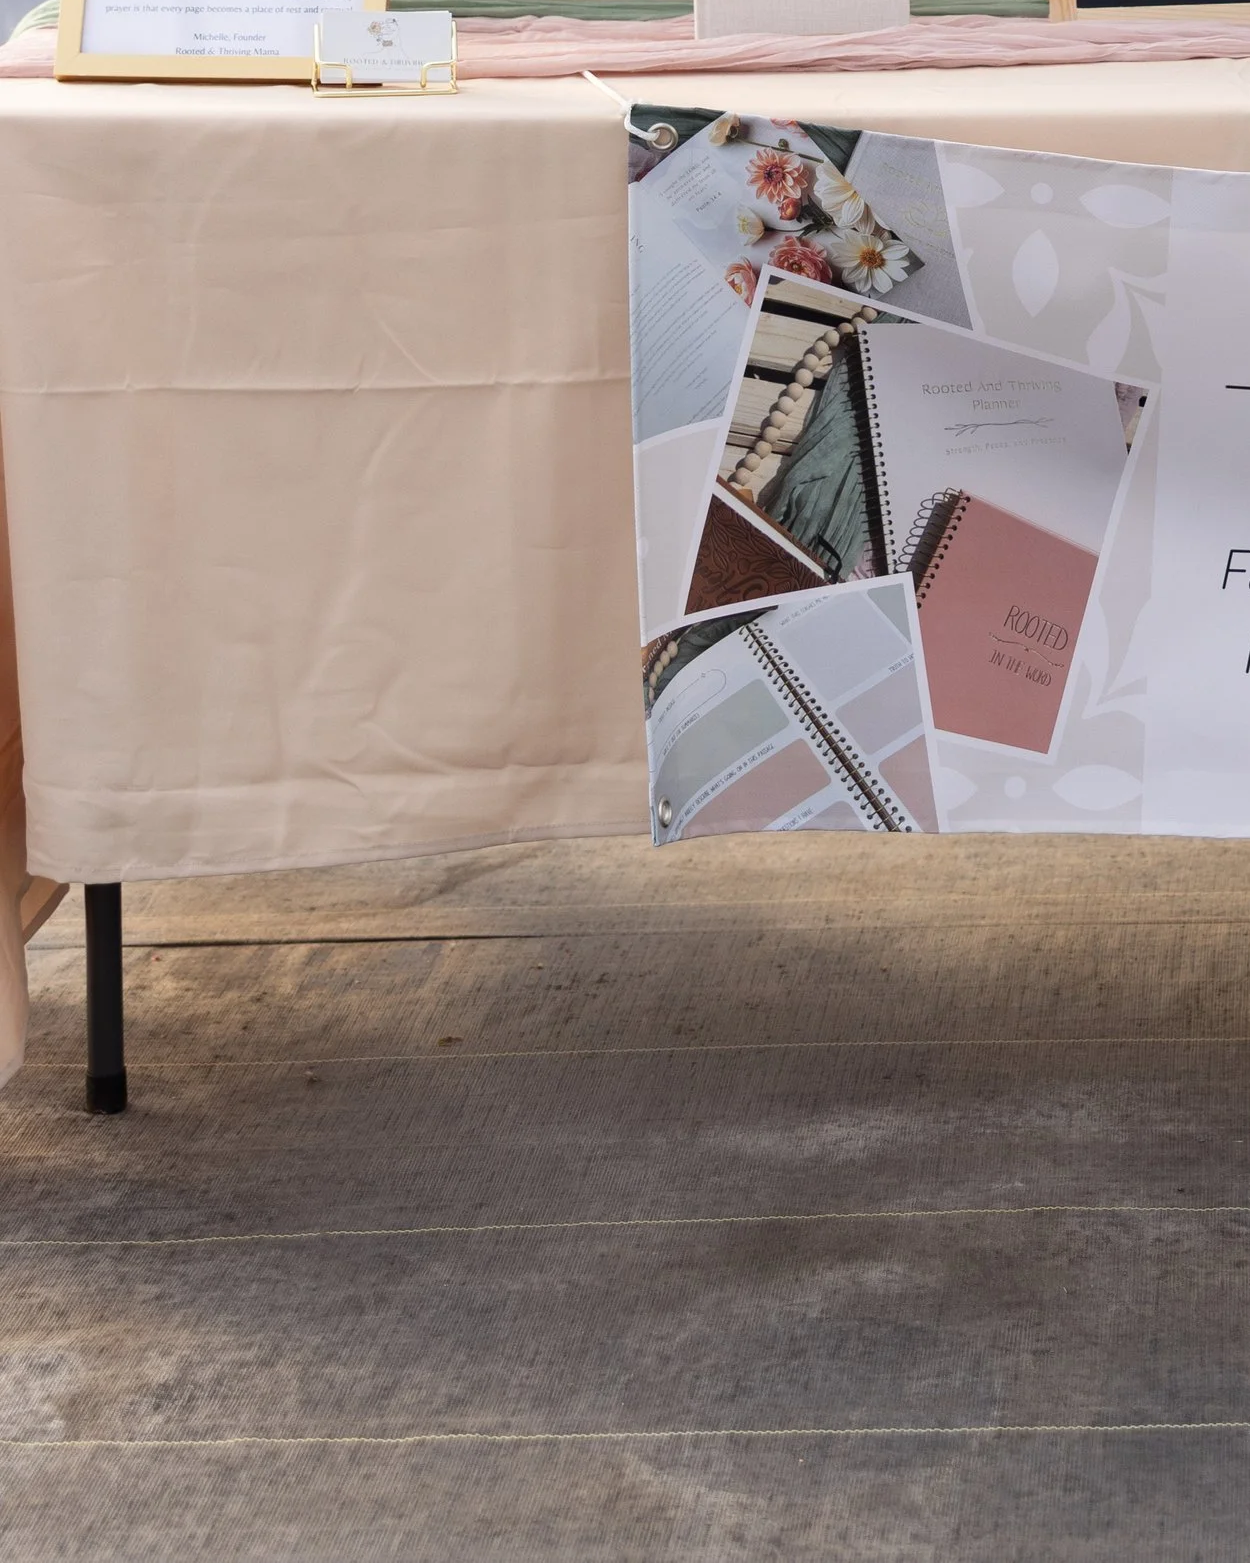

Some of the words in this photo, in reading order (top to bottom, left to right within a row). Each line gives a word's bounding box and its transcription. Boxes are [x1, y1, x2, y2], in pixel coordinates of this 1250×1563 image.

[193, 33, 231, 41] Michelle,
[233, 33, 266, 41] Founder
[176, 47, 205, 55] Rooted
[219, 48, 251, 56] Thriving
[1003, 605, 1068, 650] ROOTED
[989, 650, 1005, 666] IN
[1006, 656, 1025, 674] THE
[1026, 666, 1051, 686] WORD
